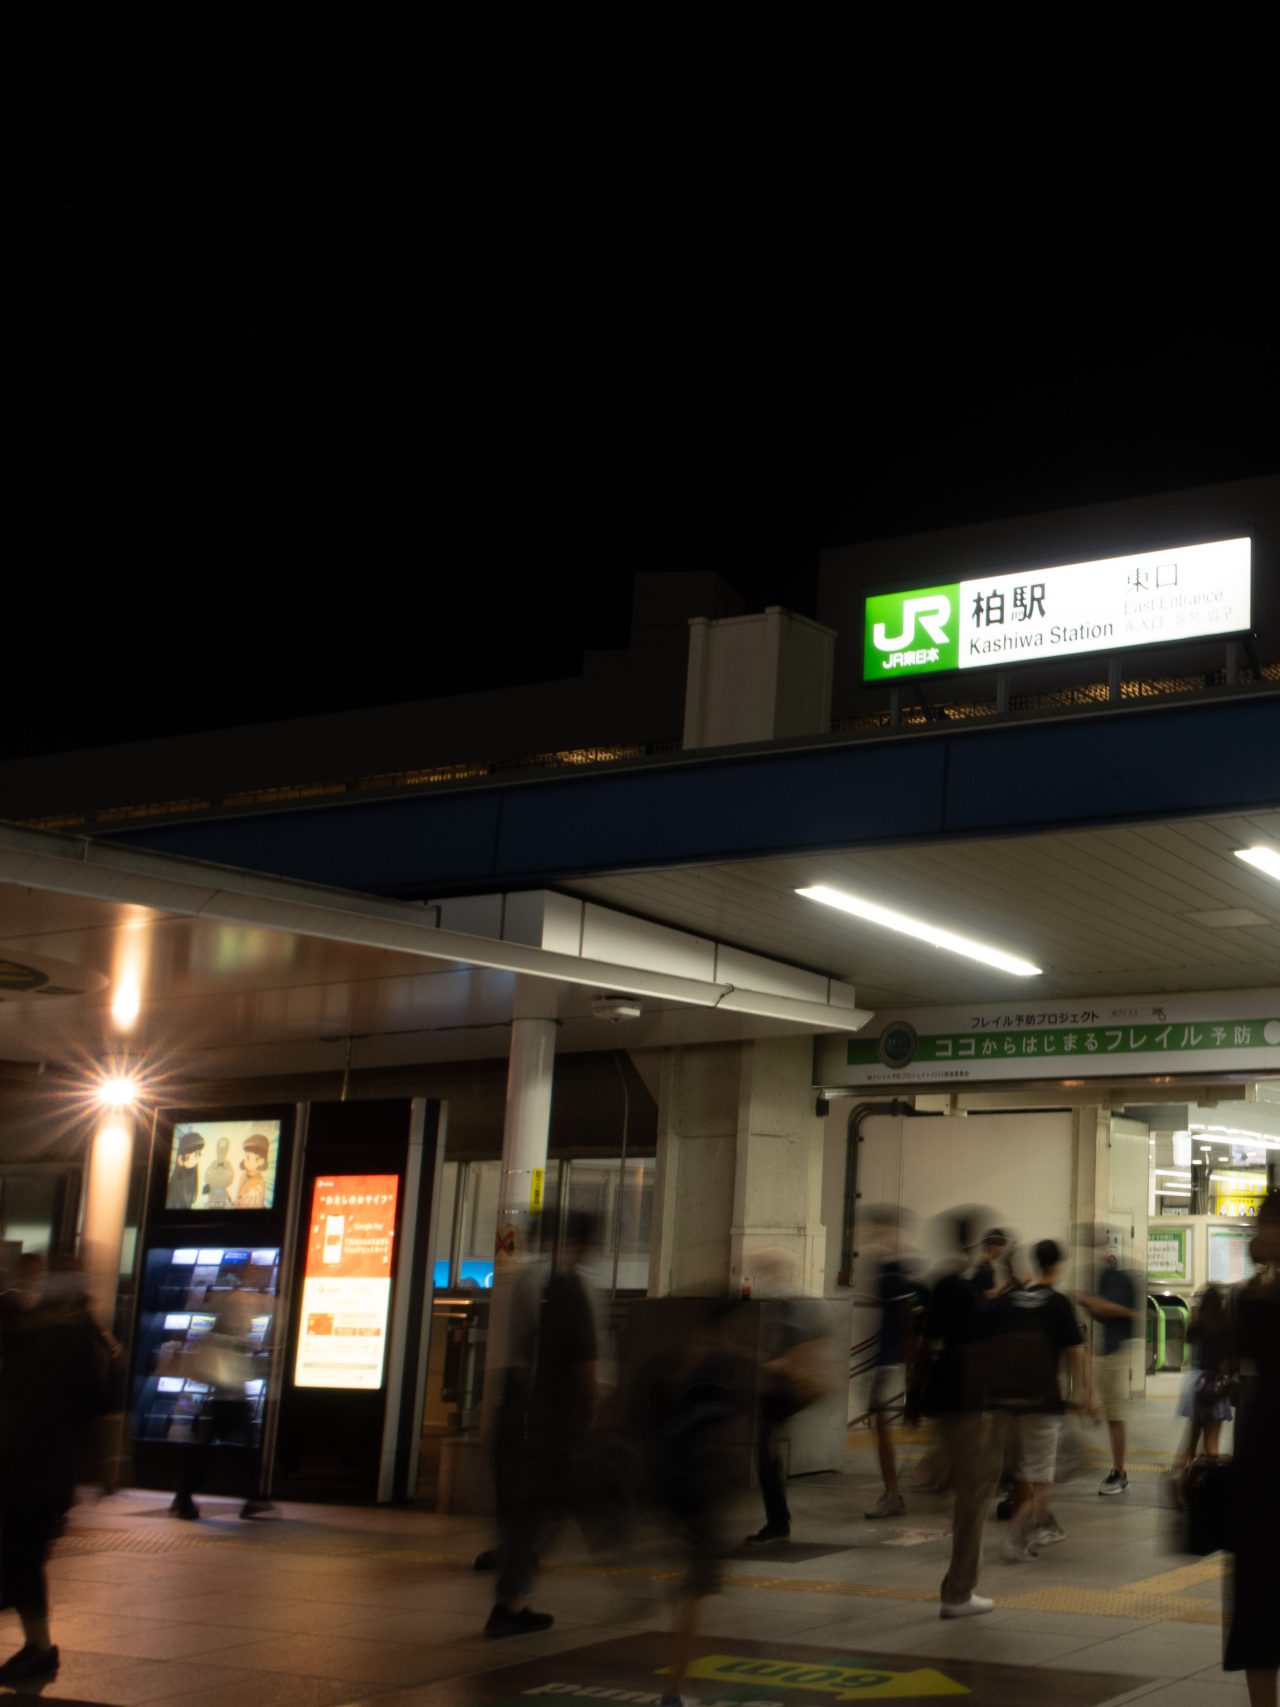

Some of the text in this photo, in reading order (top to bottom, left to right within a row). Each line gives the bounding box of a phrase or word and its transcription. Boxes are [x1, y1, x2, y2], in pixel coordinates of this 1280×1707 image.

[1126, 563, 1178, 593] 東口
[971, 583, 1046, 628] 柏駅
[873, 594, 951, 651] JR
[969, 621, 1114, 655] Kashiwa Station
[882, 647, 940, 670] JR東日本
[970, 1010, 1100, 1029] フレイル予防プロジェクト
